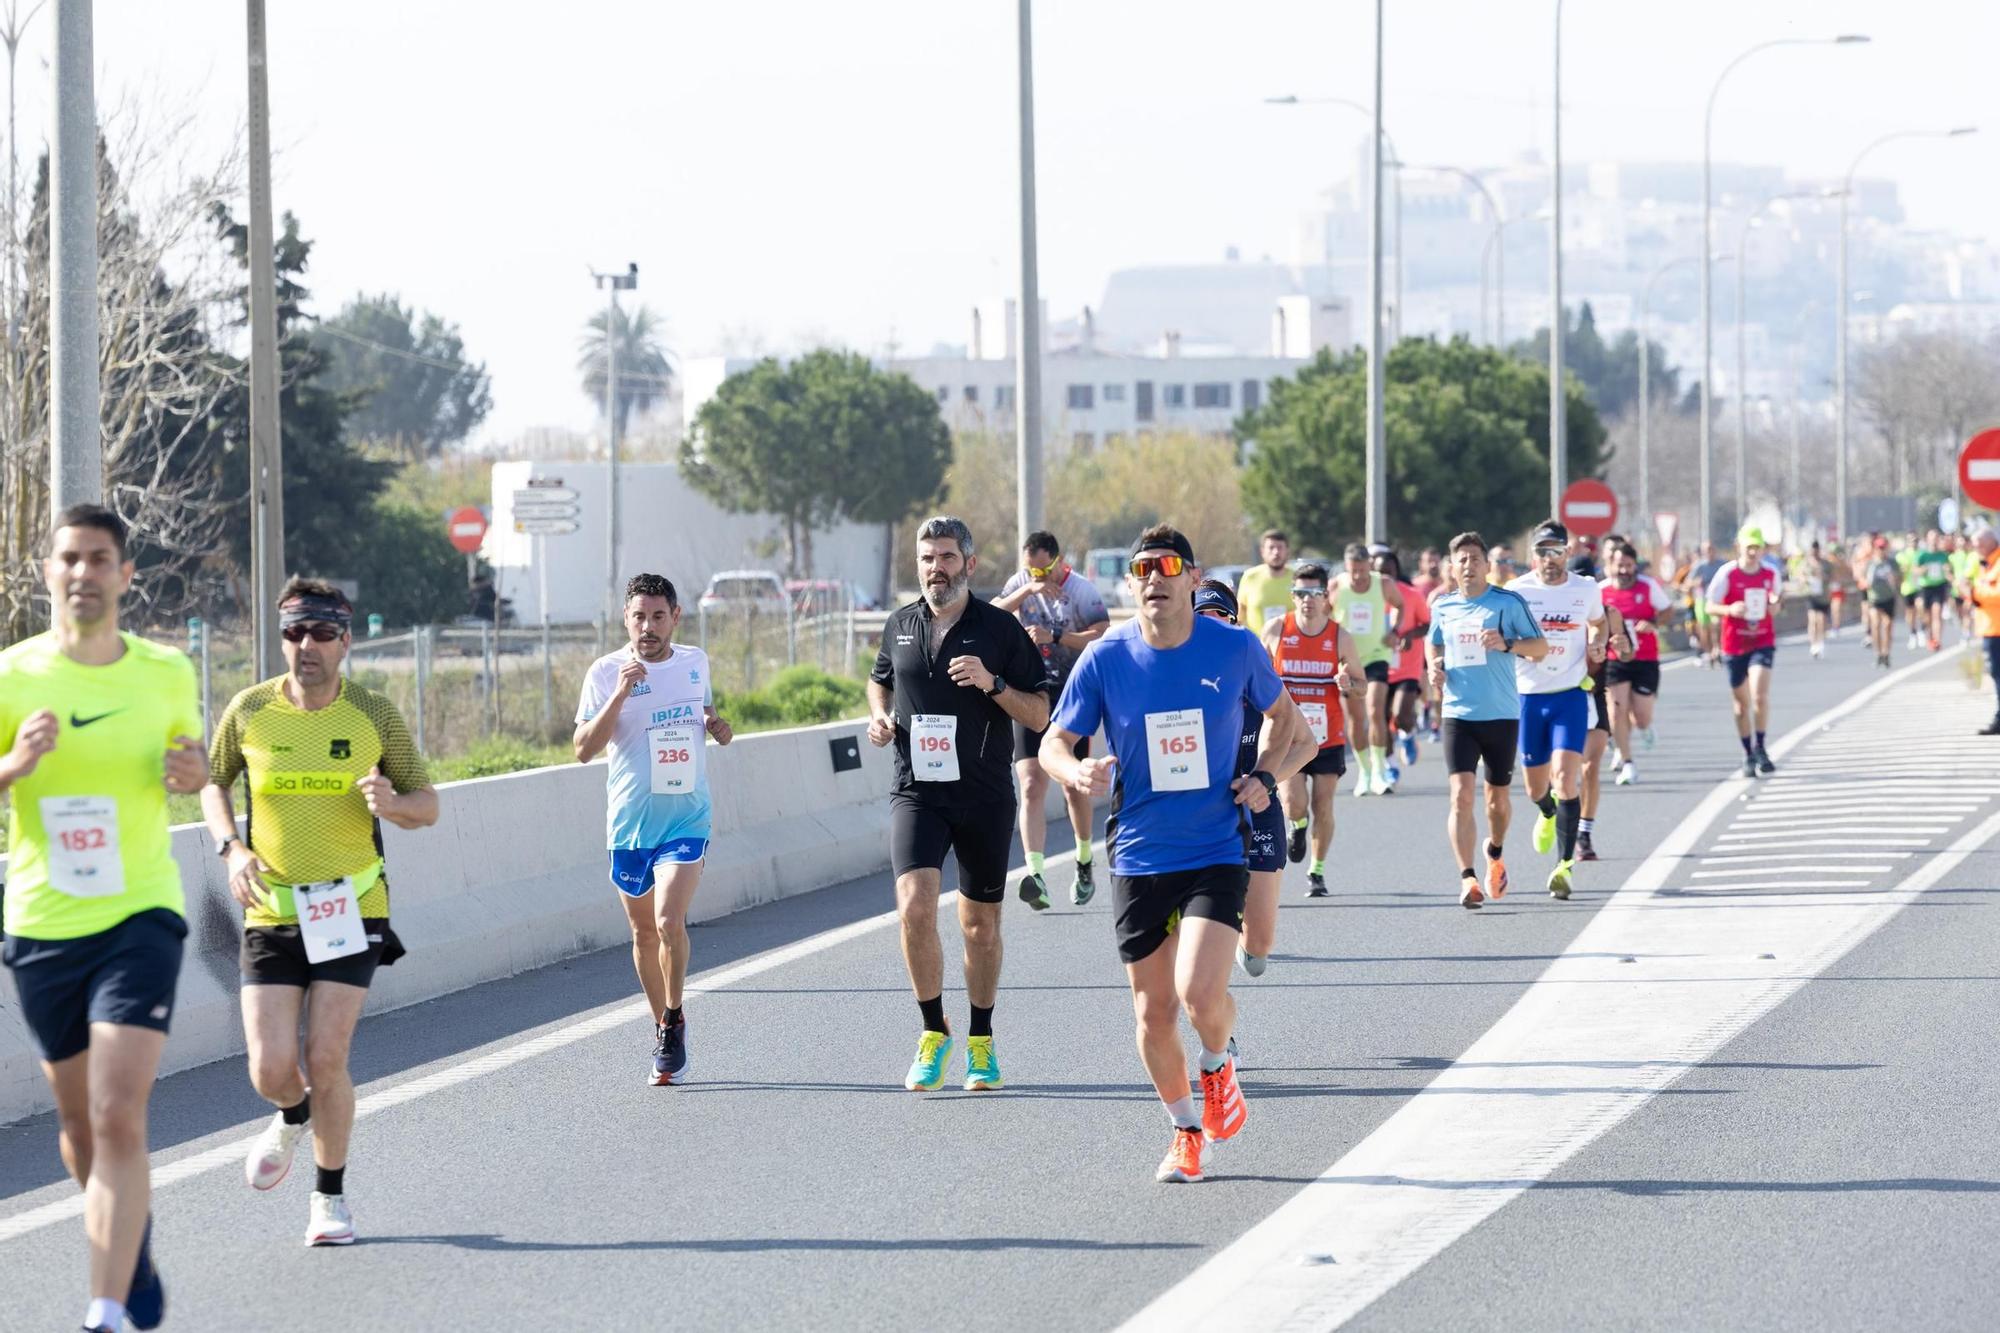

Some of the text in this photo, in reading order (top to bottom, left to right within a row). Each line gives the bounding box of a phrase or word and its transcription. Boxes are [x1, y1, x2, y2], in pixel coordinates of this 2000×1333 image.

[1459, 634, 1477, 643] 271
[1282, 660, 1334, 674] MADRID
[652, 706, 693, 724] IBIZA
[919, 736, 951, 752] 196
[1160, 735, 1198, 755] 165
[657, 749, 690, 764] 236
[274, 777, 342, 790] Sa Rota
[60, 828, 106, 851] 182
[307, 897, 347, 922] 297
